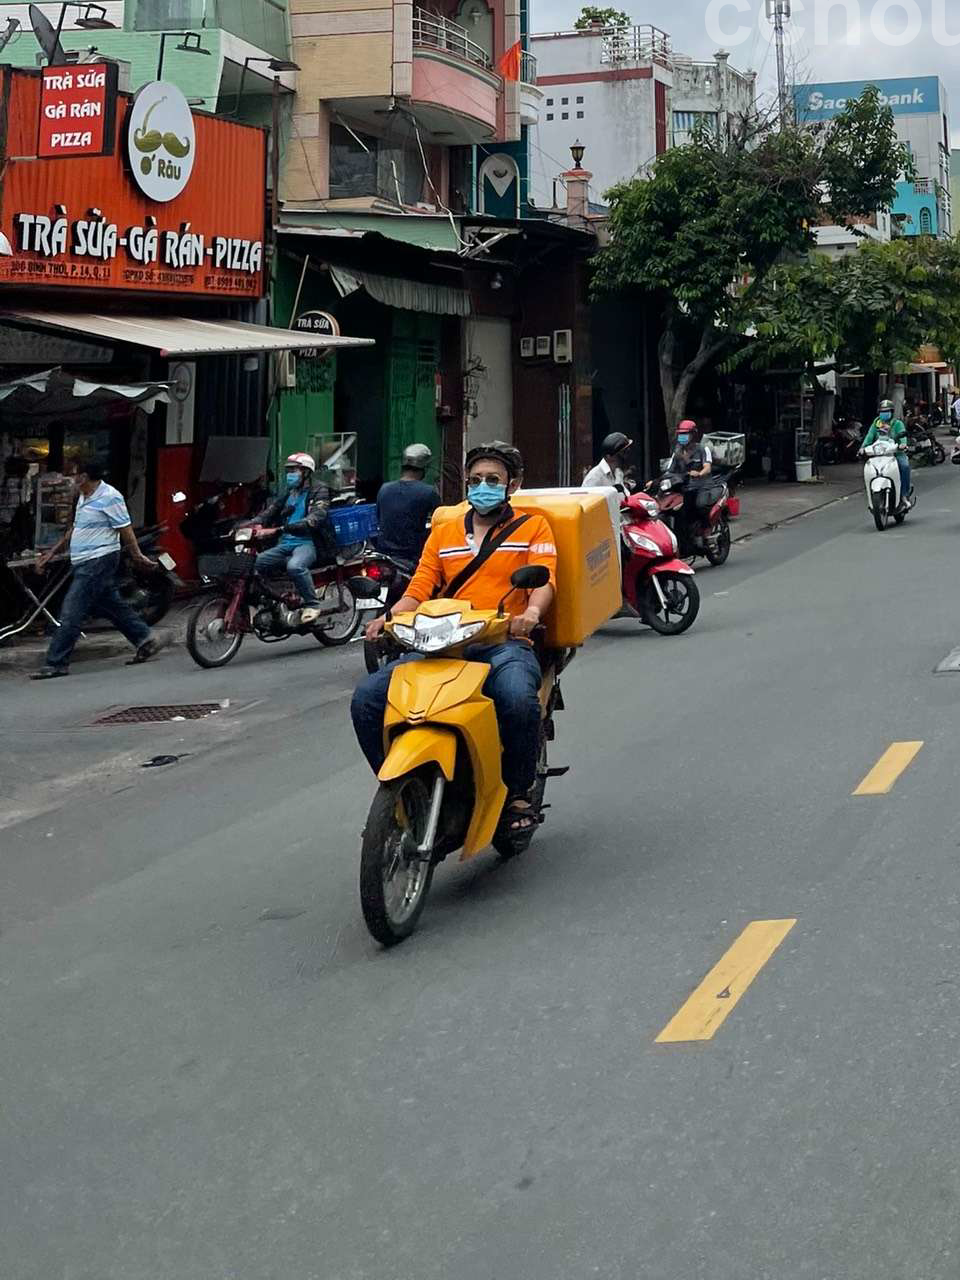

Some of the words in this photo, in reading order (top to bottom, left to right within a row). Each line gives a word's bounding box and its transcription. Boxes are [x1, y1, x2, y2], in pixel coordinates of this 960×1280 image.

[44, 72, 73, 90] TRÀ
[77, 70, 106, 88] SỮA
[808, 87, 925, 110] Sacbank
[45, 100, 67, 119] GÀ
[70, 99, 101, 118] RÁN
[51, 131, 92, 147] PIZZA
[19, 204, 68, 256] TRÀ
[129, 216, 158, 265] GÀ
[165, 222, 204, 268] RÁN
[215, 236, 262, 274] PIZZA
[297, 317, 312, 329] TRÀ
